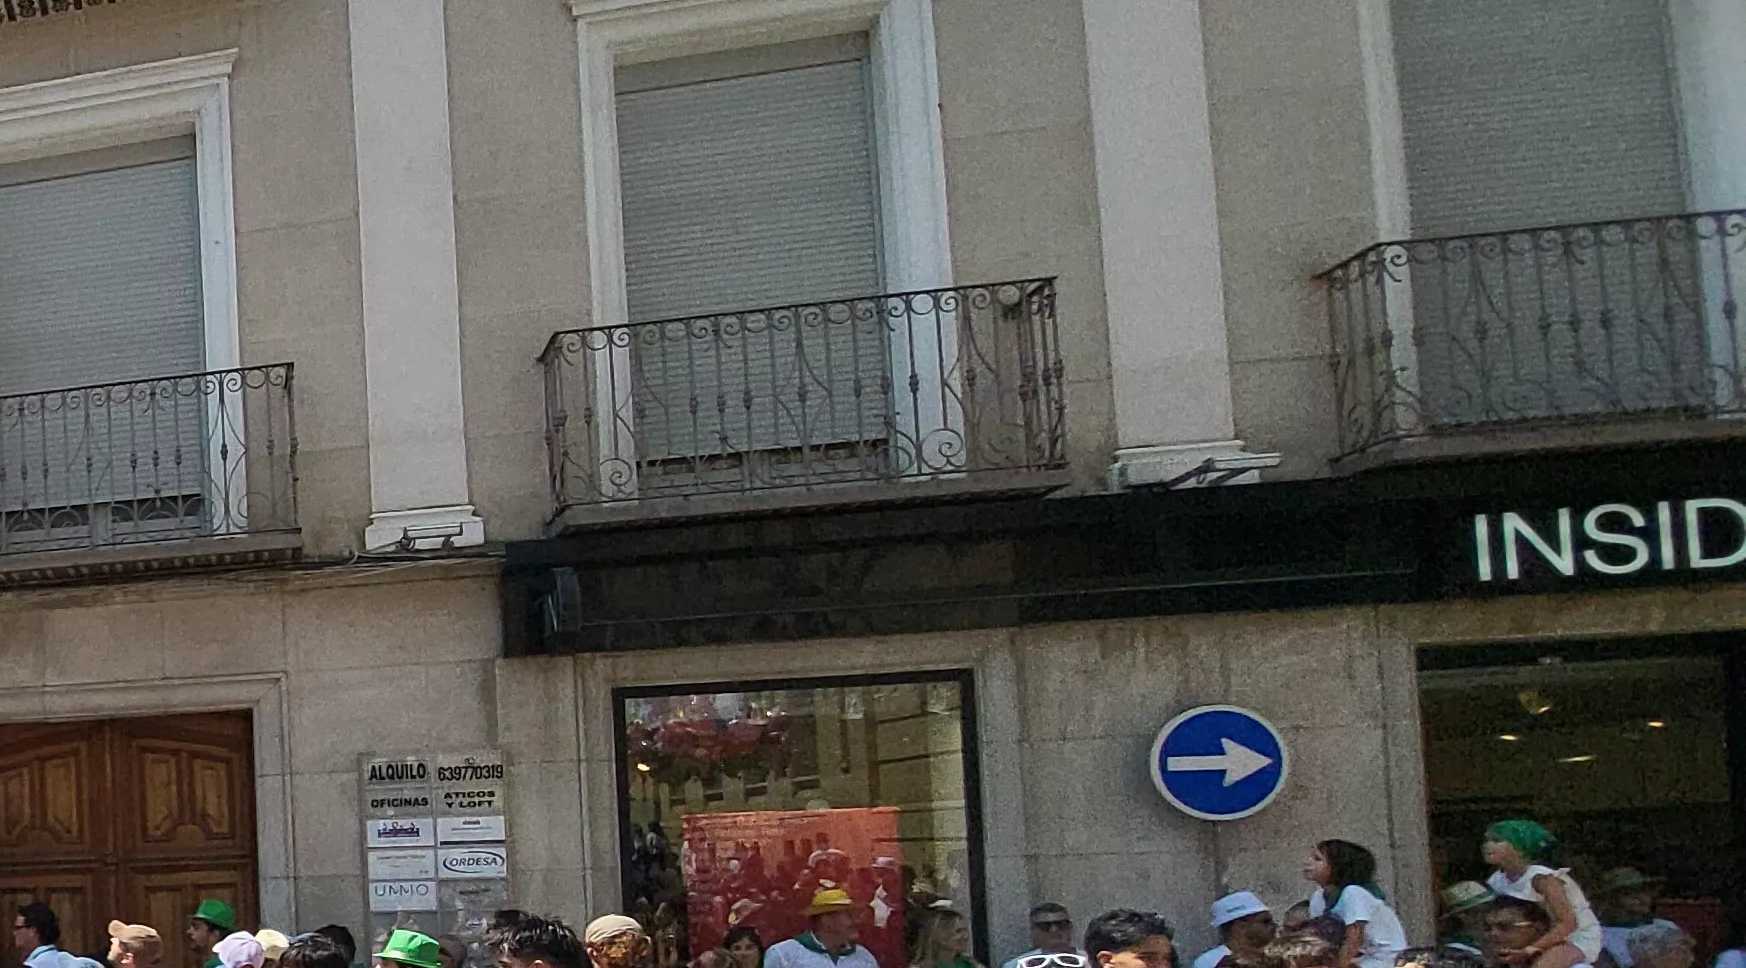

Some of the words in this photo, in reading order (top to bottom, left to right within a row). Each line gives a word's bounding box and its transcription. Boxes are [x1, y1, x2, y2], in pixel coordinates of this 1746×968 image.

[369, 763, 427, 781] ALQUILO
[438, 764, 504, 781] 639770319
[444, 791, 496, 800] ATICOS
[371, 797, 429, 808] OFICINAS
[446, 801, 455, 809] Y
[458, 800, 495, 809] LOFT
[449, 857, 499, 867] ORDESA
